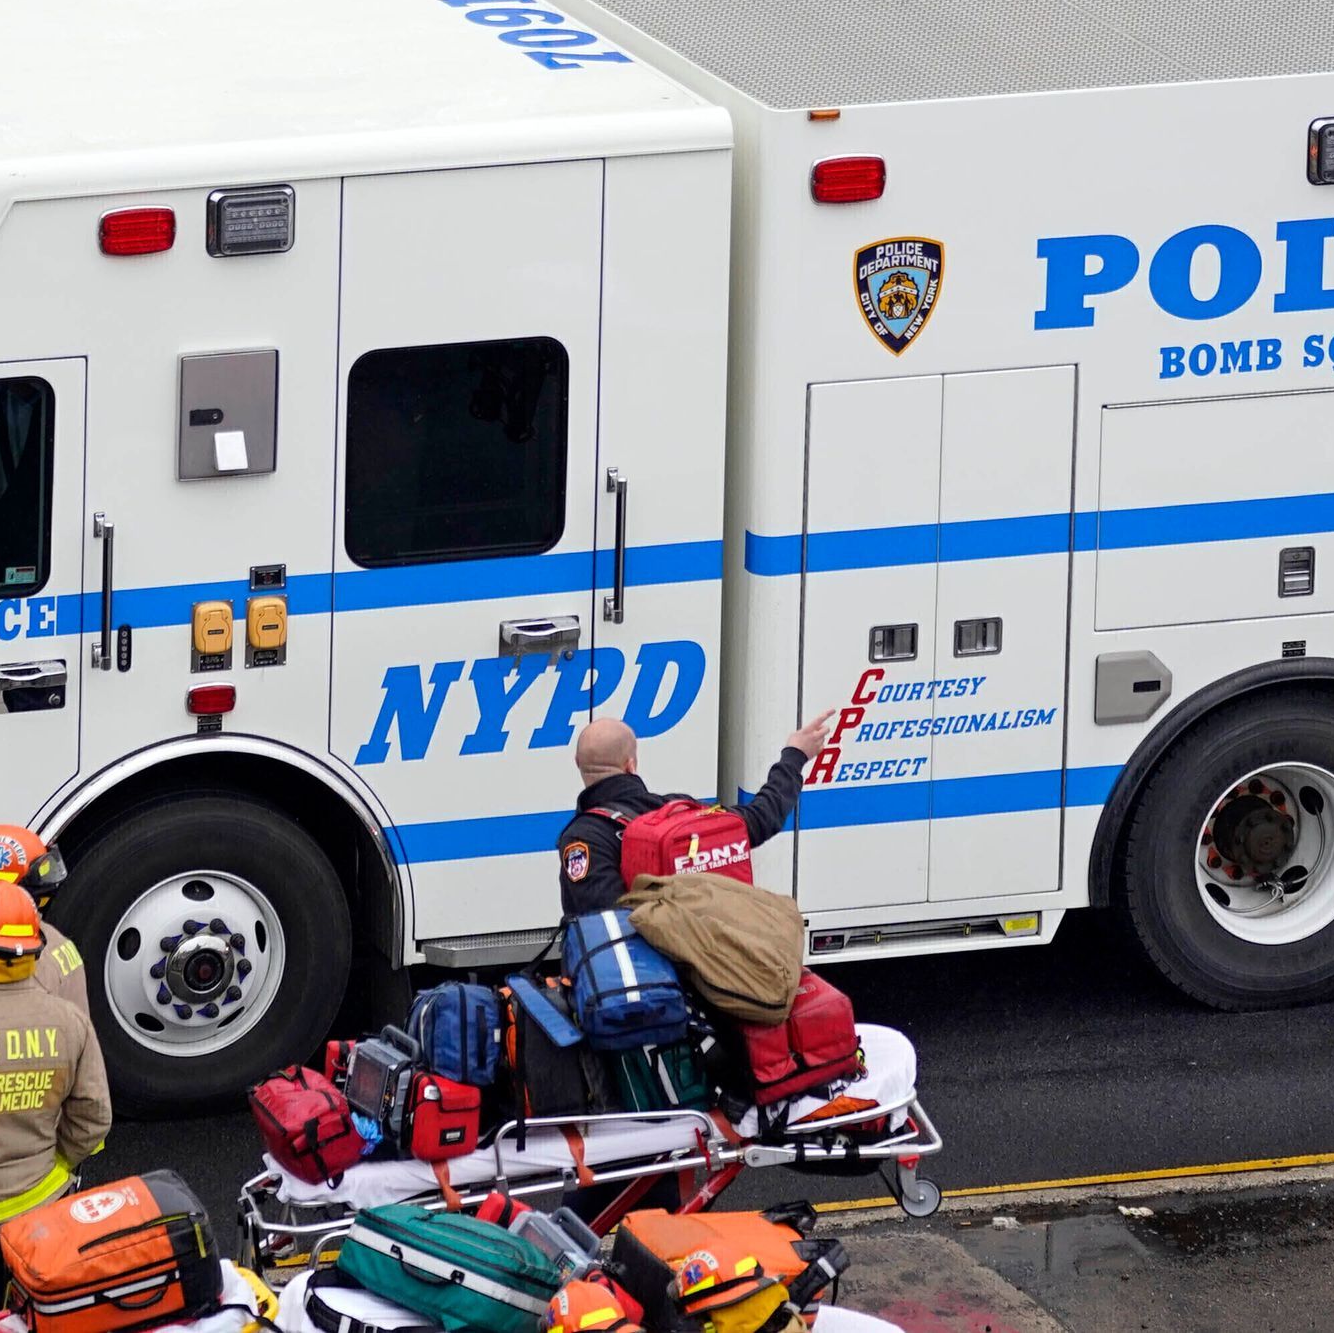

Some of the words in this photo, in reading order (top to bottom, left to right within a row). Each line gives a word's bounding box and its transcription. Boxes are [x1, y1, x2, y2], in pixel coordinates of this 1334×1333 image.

[859, 254, 939, 281] DEPARTMENT
[875, 241, 924, 260] POLICE
[1158, 337, 1283, 381] BOMB
[354, 639, 706, 767] NYPD
[850, 668, 987, 707] COURTESY
[828, 706, 1057, 749] PROFESSIONALISM
[804, 747, 927, 786] RESPECT
[674, 839, 748, 870] FDNY
